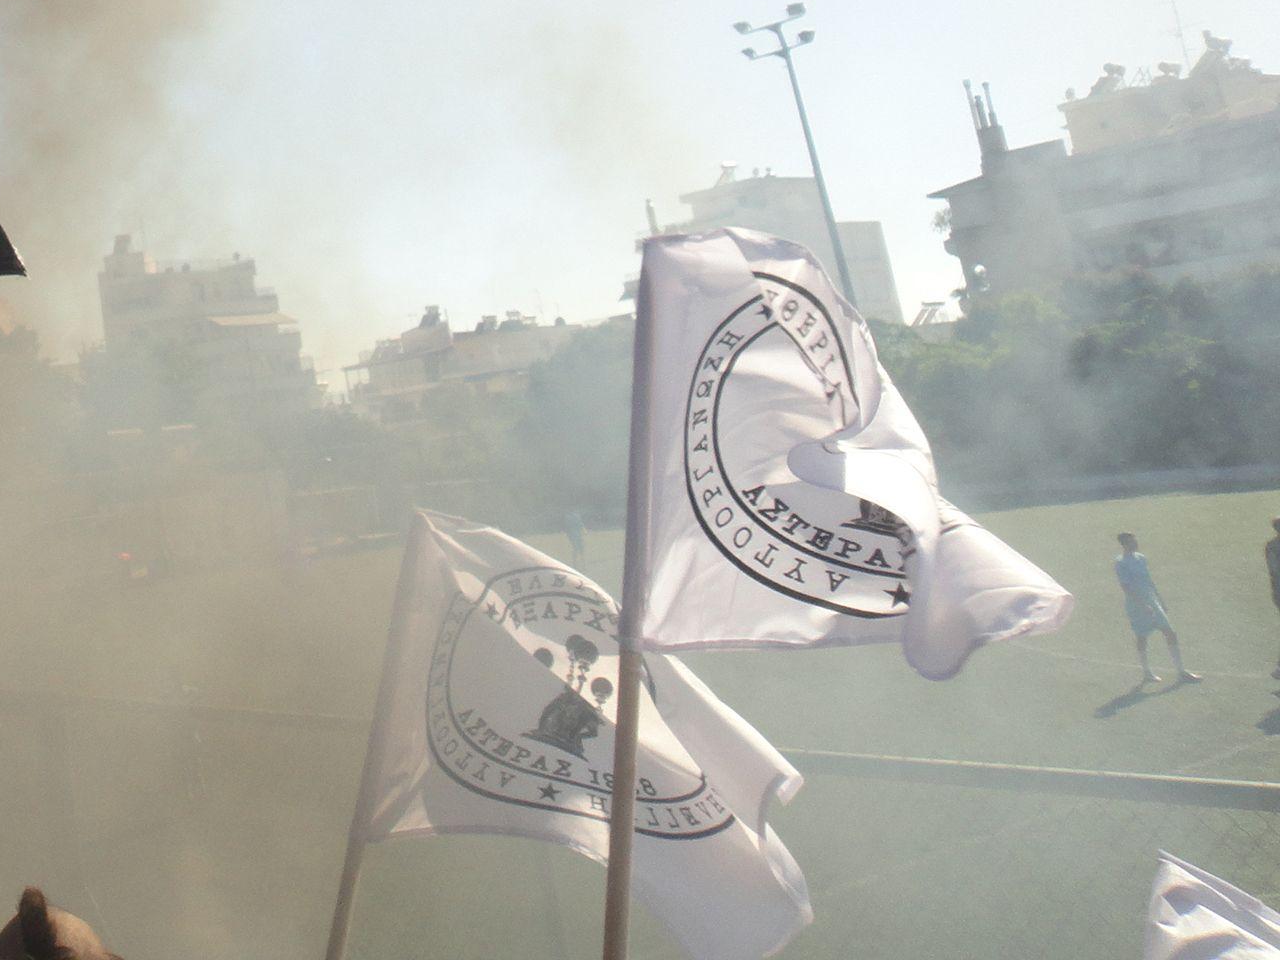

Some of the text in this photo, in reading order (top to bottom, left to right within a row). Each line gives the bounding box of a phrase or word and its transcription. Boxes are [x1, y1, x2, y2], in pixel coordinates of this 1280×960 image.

[693, 331, 851, 592] ΑΥΤΟΟΡΓΑΝΩΣΗ
[458, 709, 657, 796] ΑΣΤΕΡΑΣ 198
